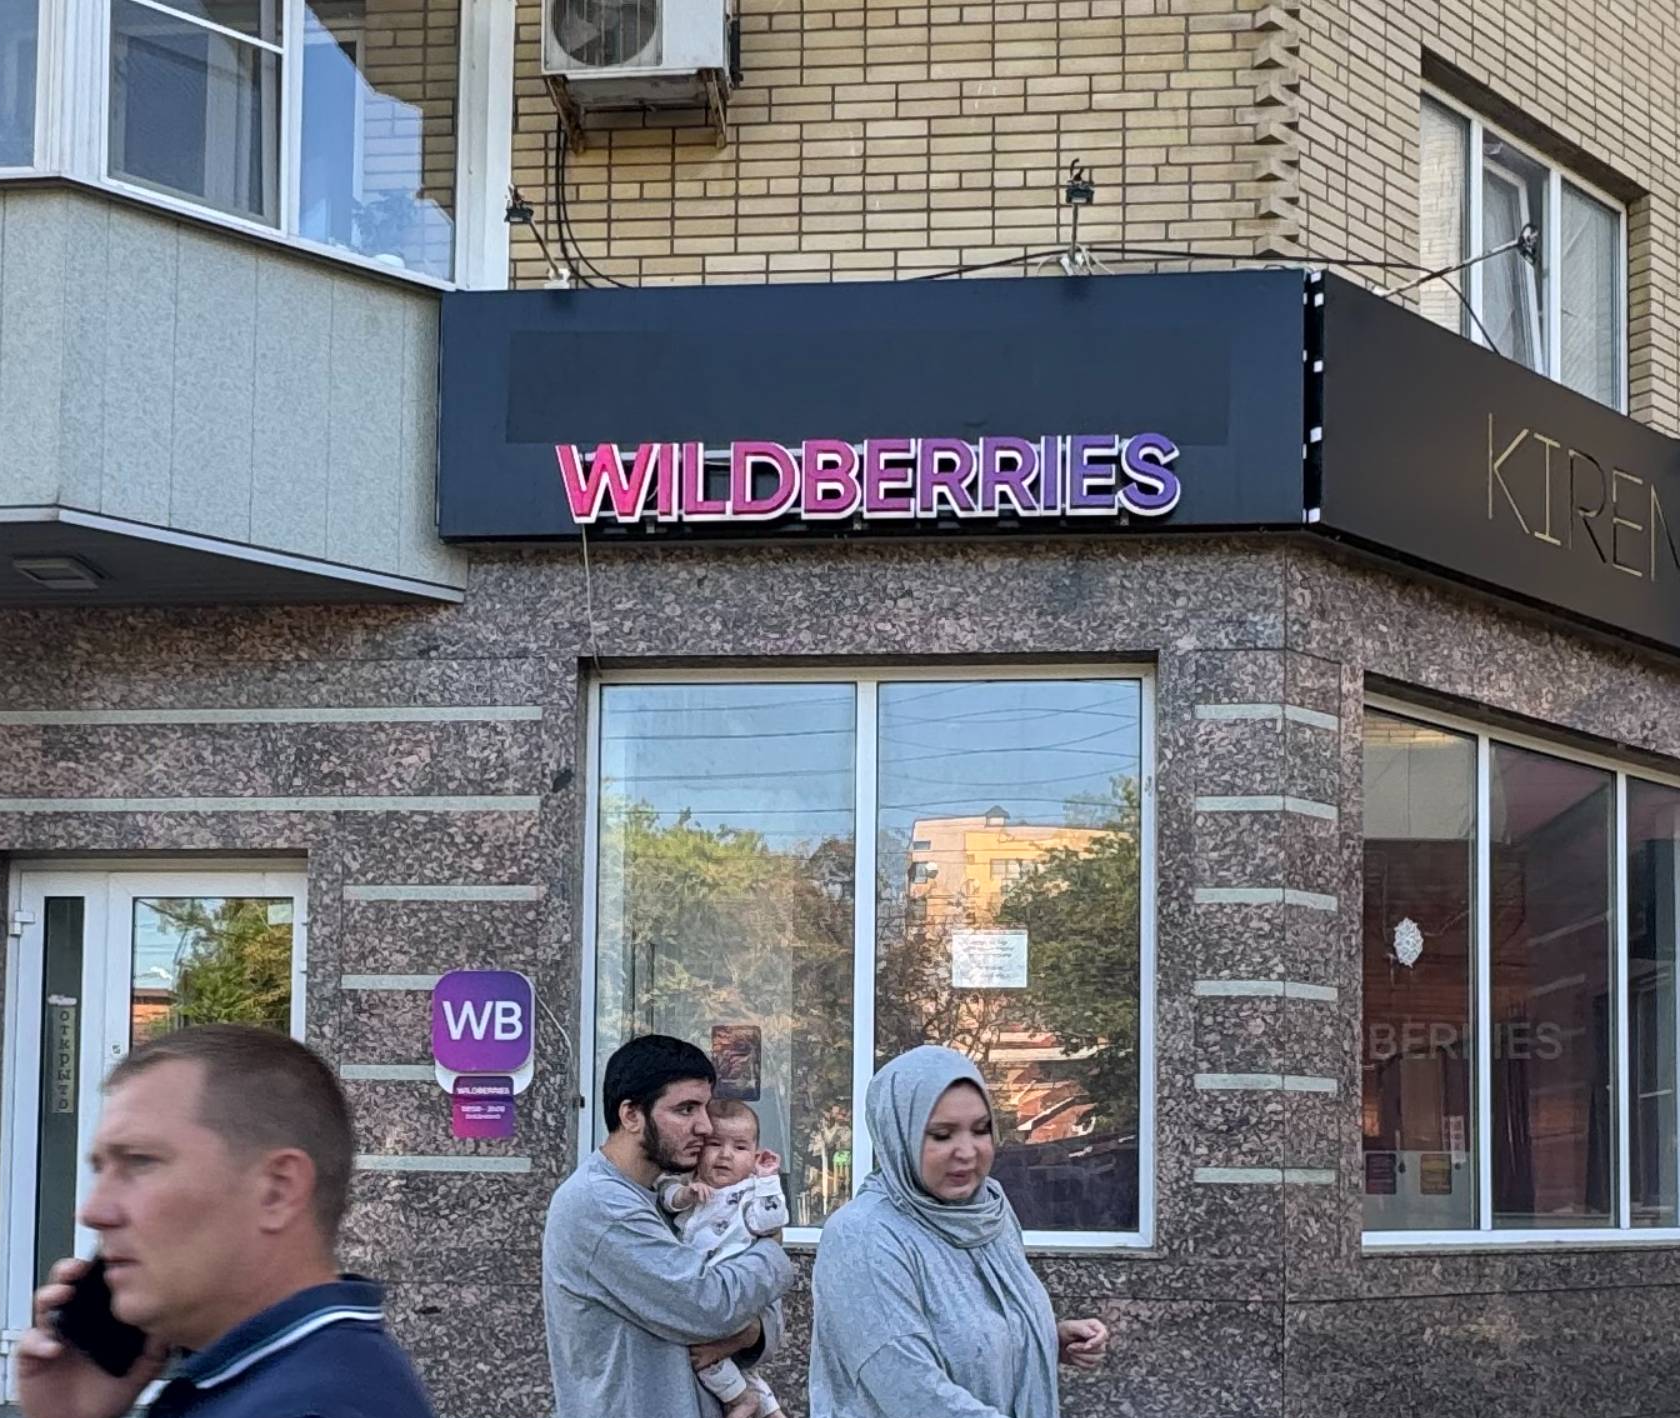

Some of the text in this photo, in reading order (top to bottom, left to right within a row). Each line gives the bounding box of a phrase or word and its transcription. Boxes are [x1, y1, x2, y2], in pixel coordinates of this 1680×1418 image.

[555, 433, 1181, 524] WILDBERRIES
[441, 1000, 524, 1041] WB
[1370, 1022, 1563, 1061] BERIES
[57, 1010, 72, 1110] ОТКРЫТО
